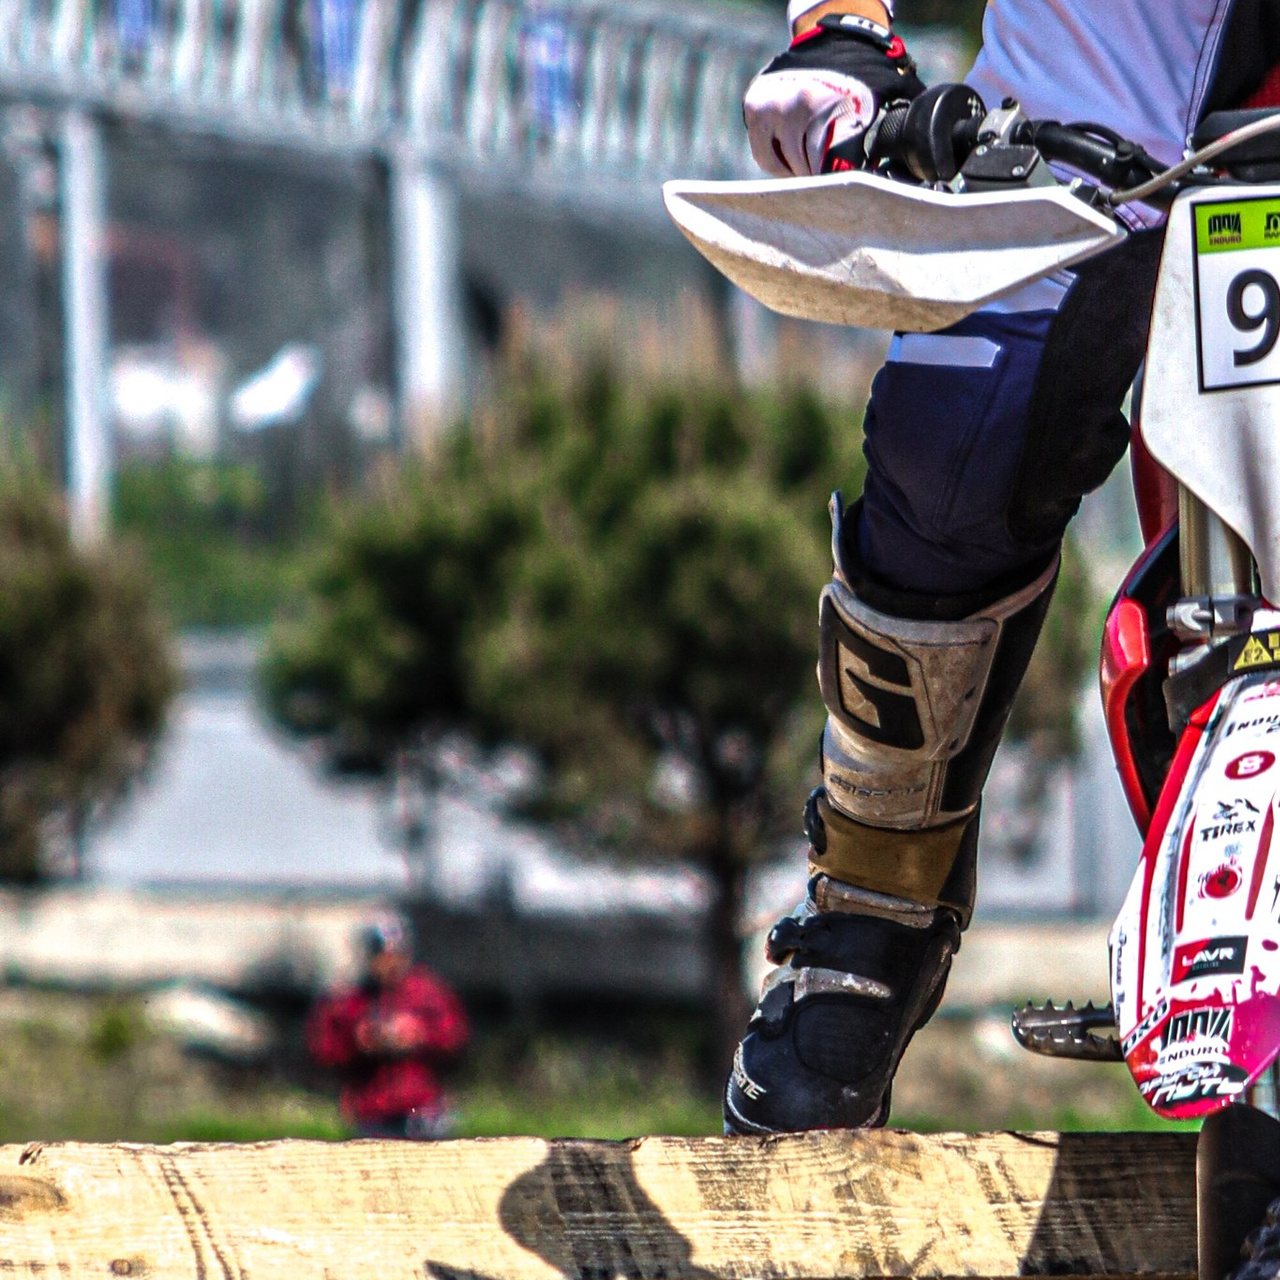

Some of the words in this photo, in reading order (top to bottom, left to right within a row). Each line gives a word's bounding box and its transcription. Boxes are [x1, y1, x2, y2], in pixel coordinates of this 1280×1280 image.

[1209, 234, 1242, 245] ENDURO
[1200, 820, 1257, 842] TIREX
[1182, 947, 1237, 968] LAVR
[1159, 1046, 1227, 1065] ENDURO
